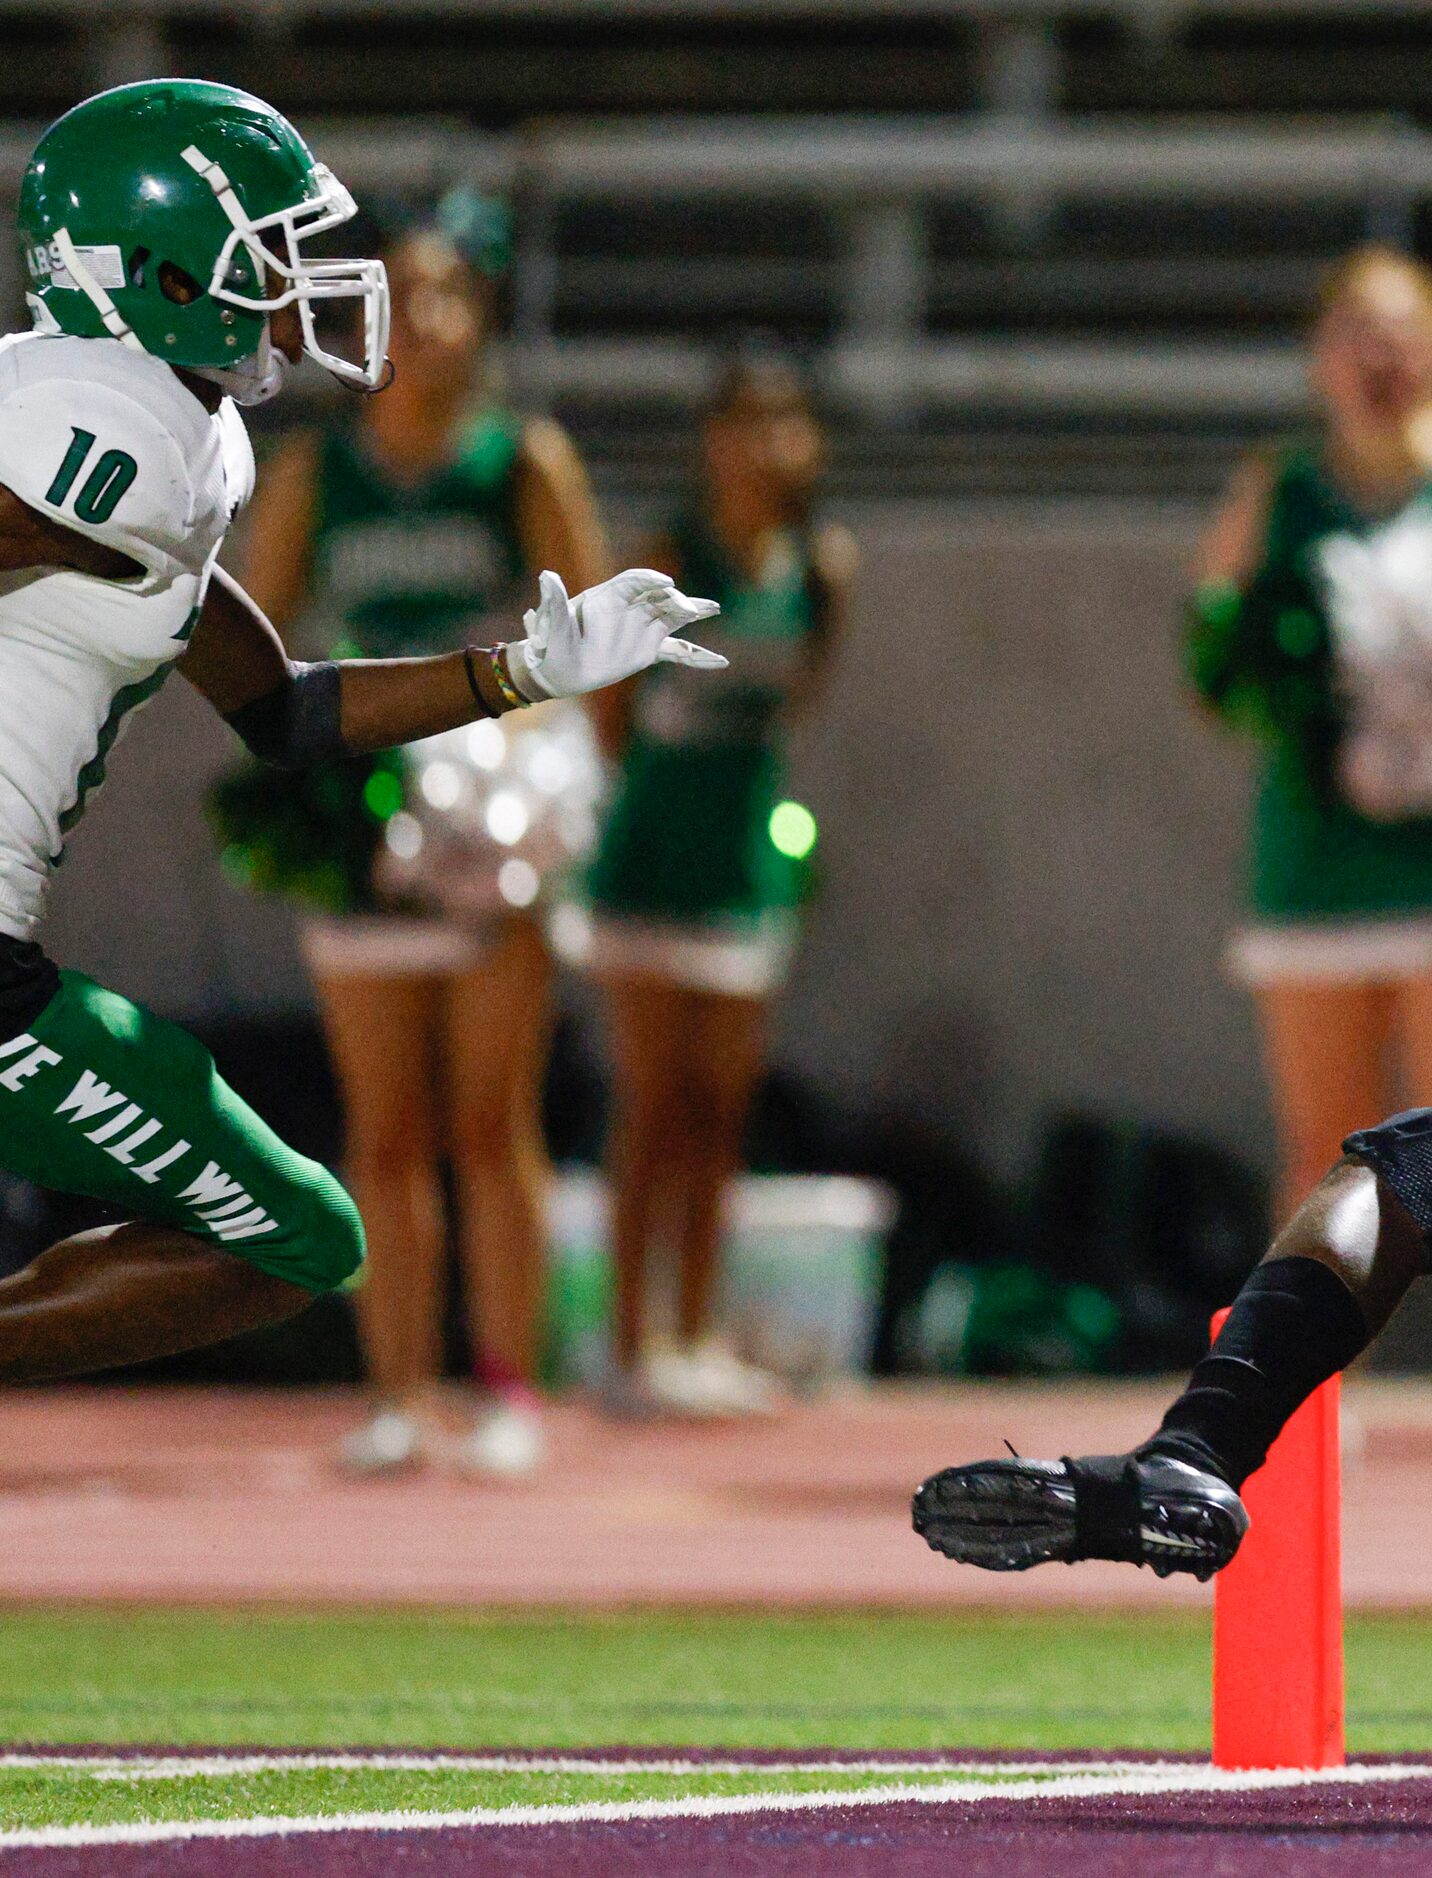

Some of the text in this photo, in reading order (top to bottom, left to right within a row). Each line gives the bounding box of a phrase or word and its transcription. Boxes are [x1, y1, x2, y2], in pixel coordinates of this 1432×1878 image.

[44, 426, 138, 525] 10
[0, 1033, 280, 1241] E WILL WIN
